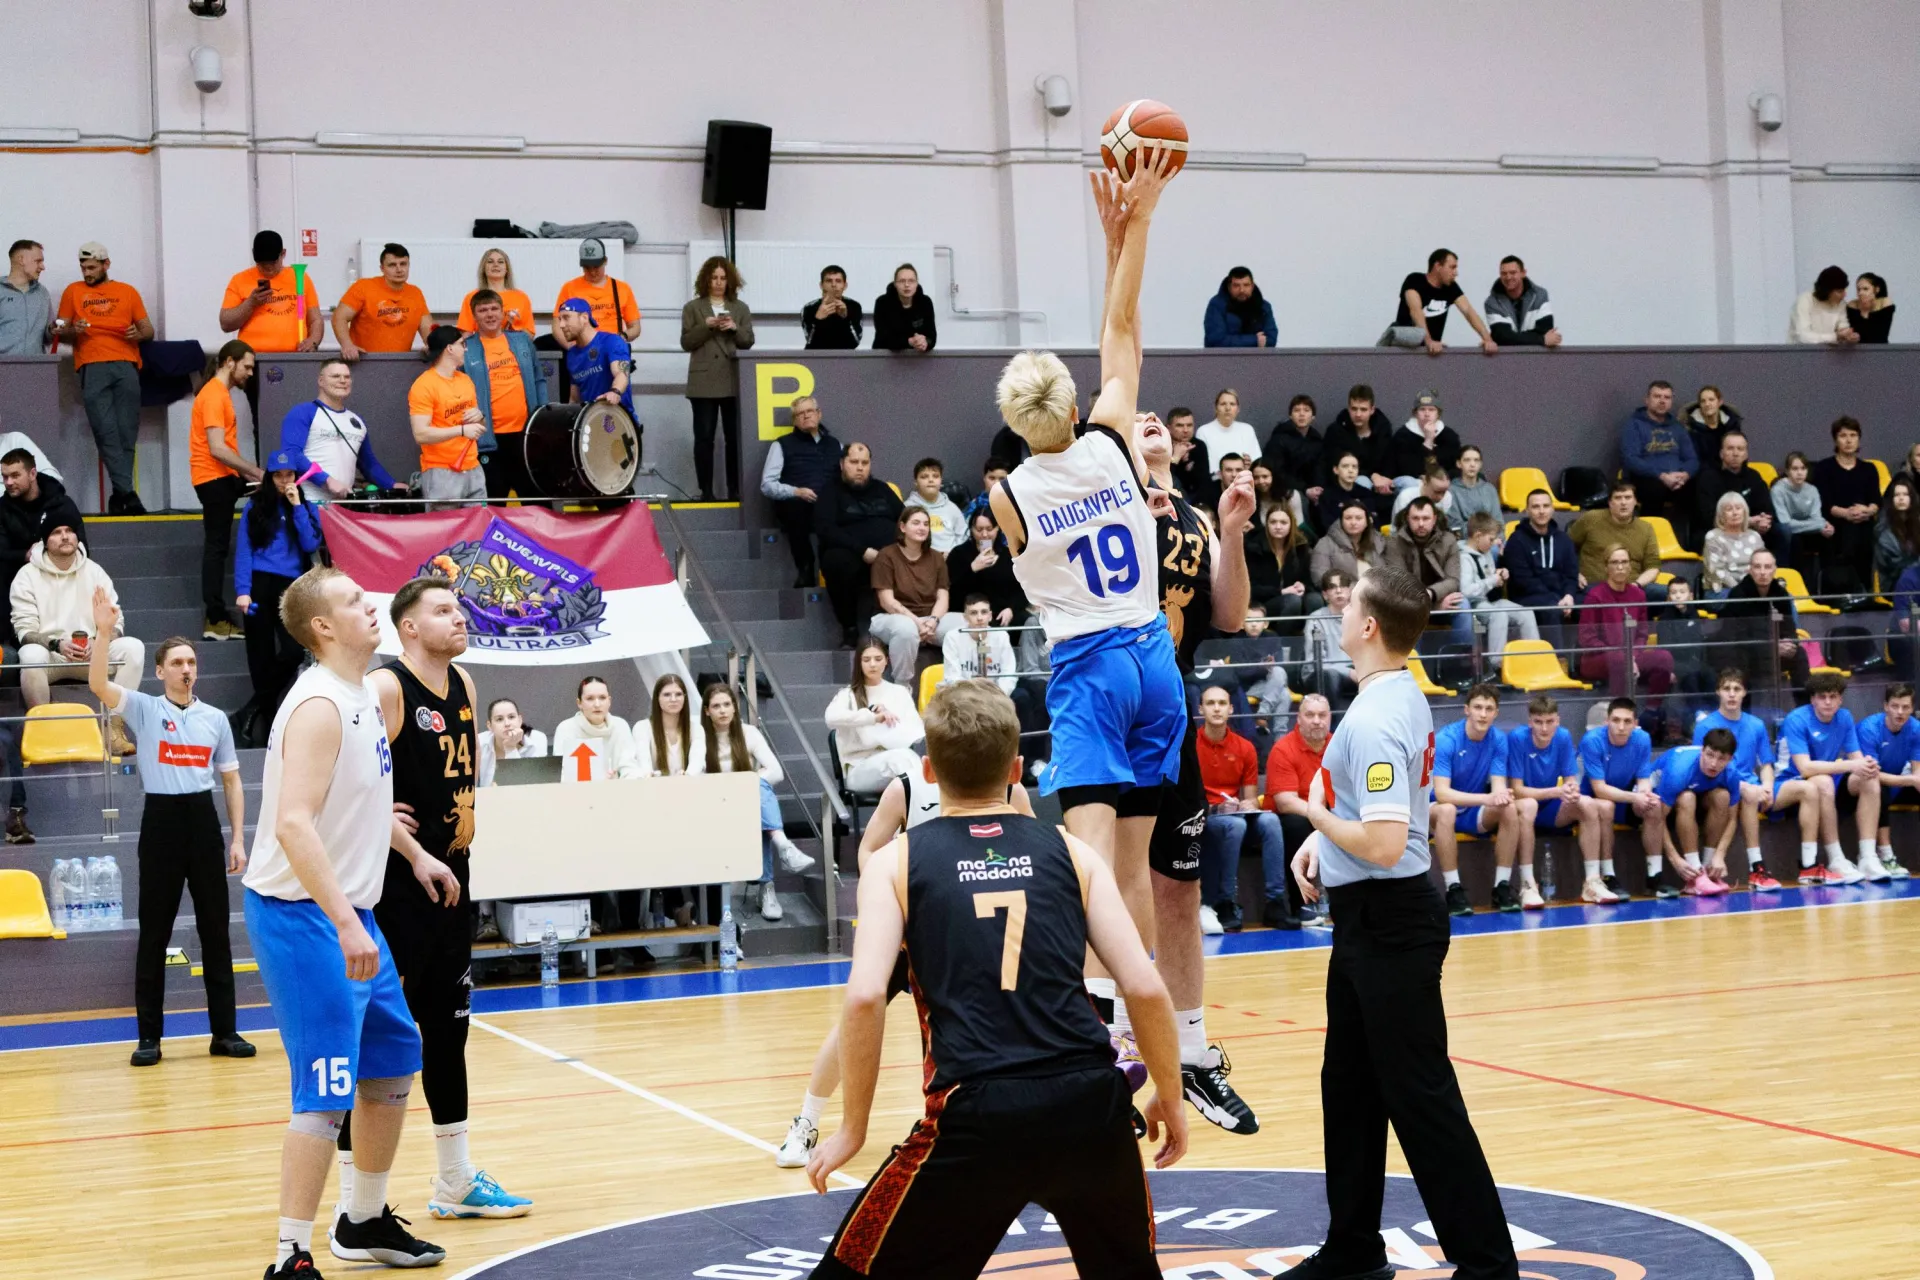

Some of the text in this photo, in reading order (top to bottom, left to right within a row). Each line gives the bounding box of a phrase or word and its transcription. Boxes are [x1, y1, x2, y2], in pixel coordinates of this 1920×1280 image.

[756, 363, 815, 441] B
[1037, 480, 1133, 537] DAUGAVPILS
[491, 530, 579, 584] DAUGAVPILS
[1066, 524, 1140, 599] 19
[1163, 526, 1204, 577] 23
[477, 636, 577, 650] ULTRAS
[375, 736, 392, 777] 15
[438, 733, 473, 778] 24
[959, 866, 1033, 882] madona
[972, 890, 1028, 992] 7
[312, 1057, 352, 1097] 15
